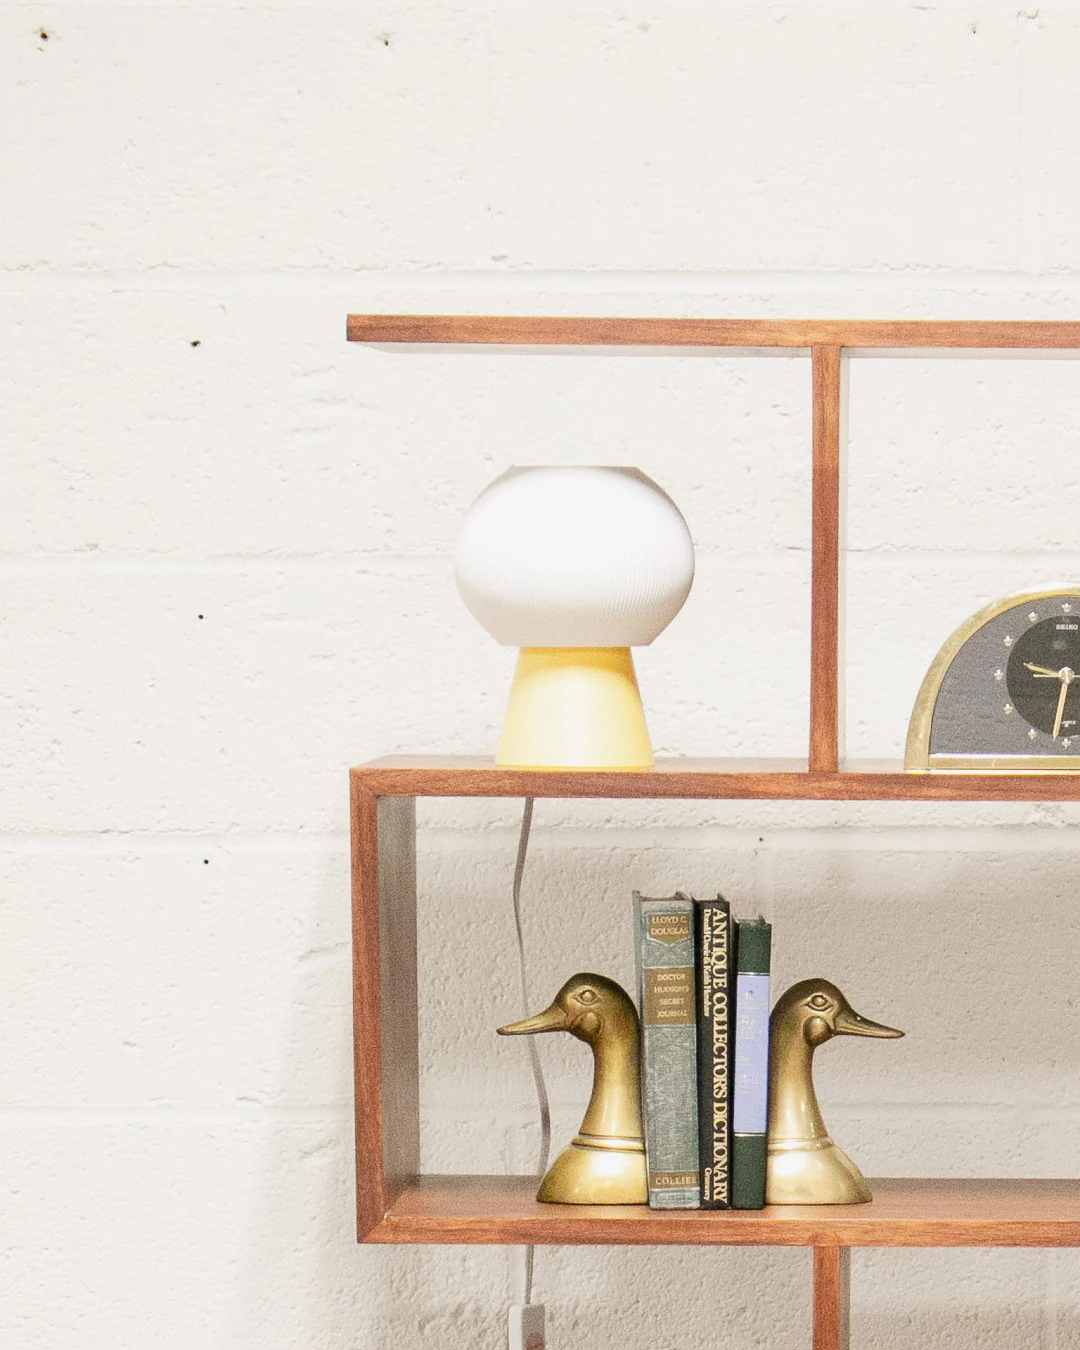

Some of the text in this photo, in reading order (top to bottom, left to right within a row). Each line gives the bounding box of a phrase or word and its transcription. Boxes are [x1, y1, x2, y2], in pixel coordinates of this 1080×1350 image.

[652, 916, 679, 924] LLOYD
[703, 909, 712, 934] Donald
[651, 927, 689, 936] DOUGLAS
[711, 908, 728, 989] ANTIQUE
[703, 957, 710, 966] &
[657, 973, 686, 981] DOCTOR
[703, 966, 712, 985] Keith
[713, 1101, 728, 1204] DICTIONARY
[656, 1176, 697, 1185] COLLIER
[703, 1167, 712, 1200] Gramercy
